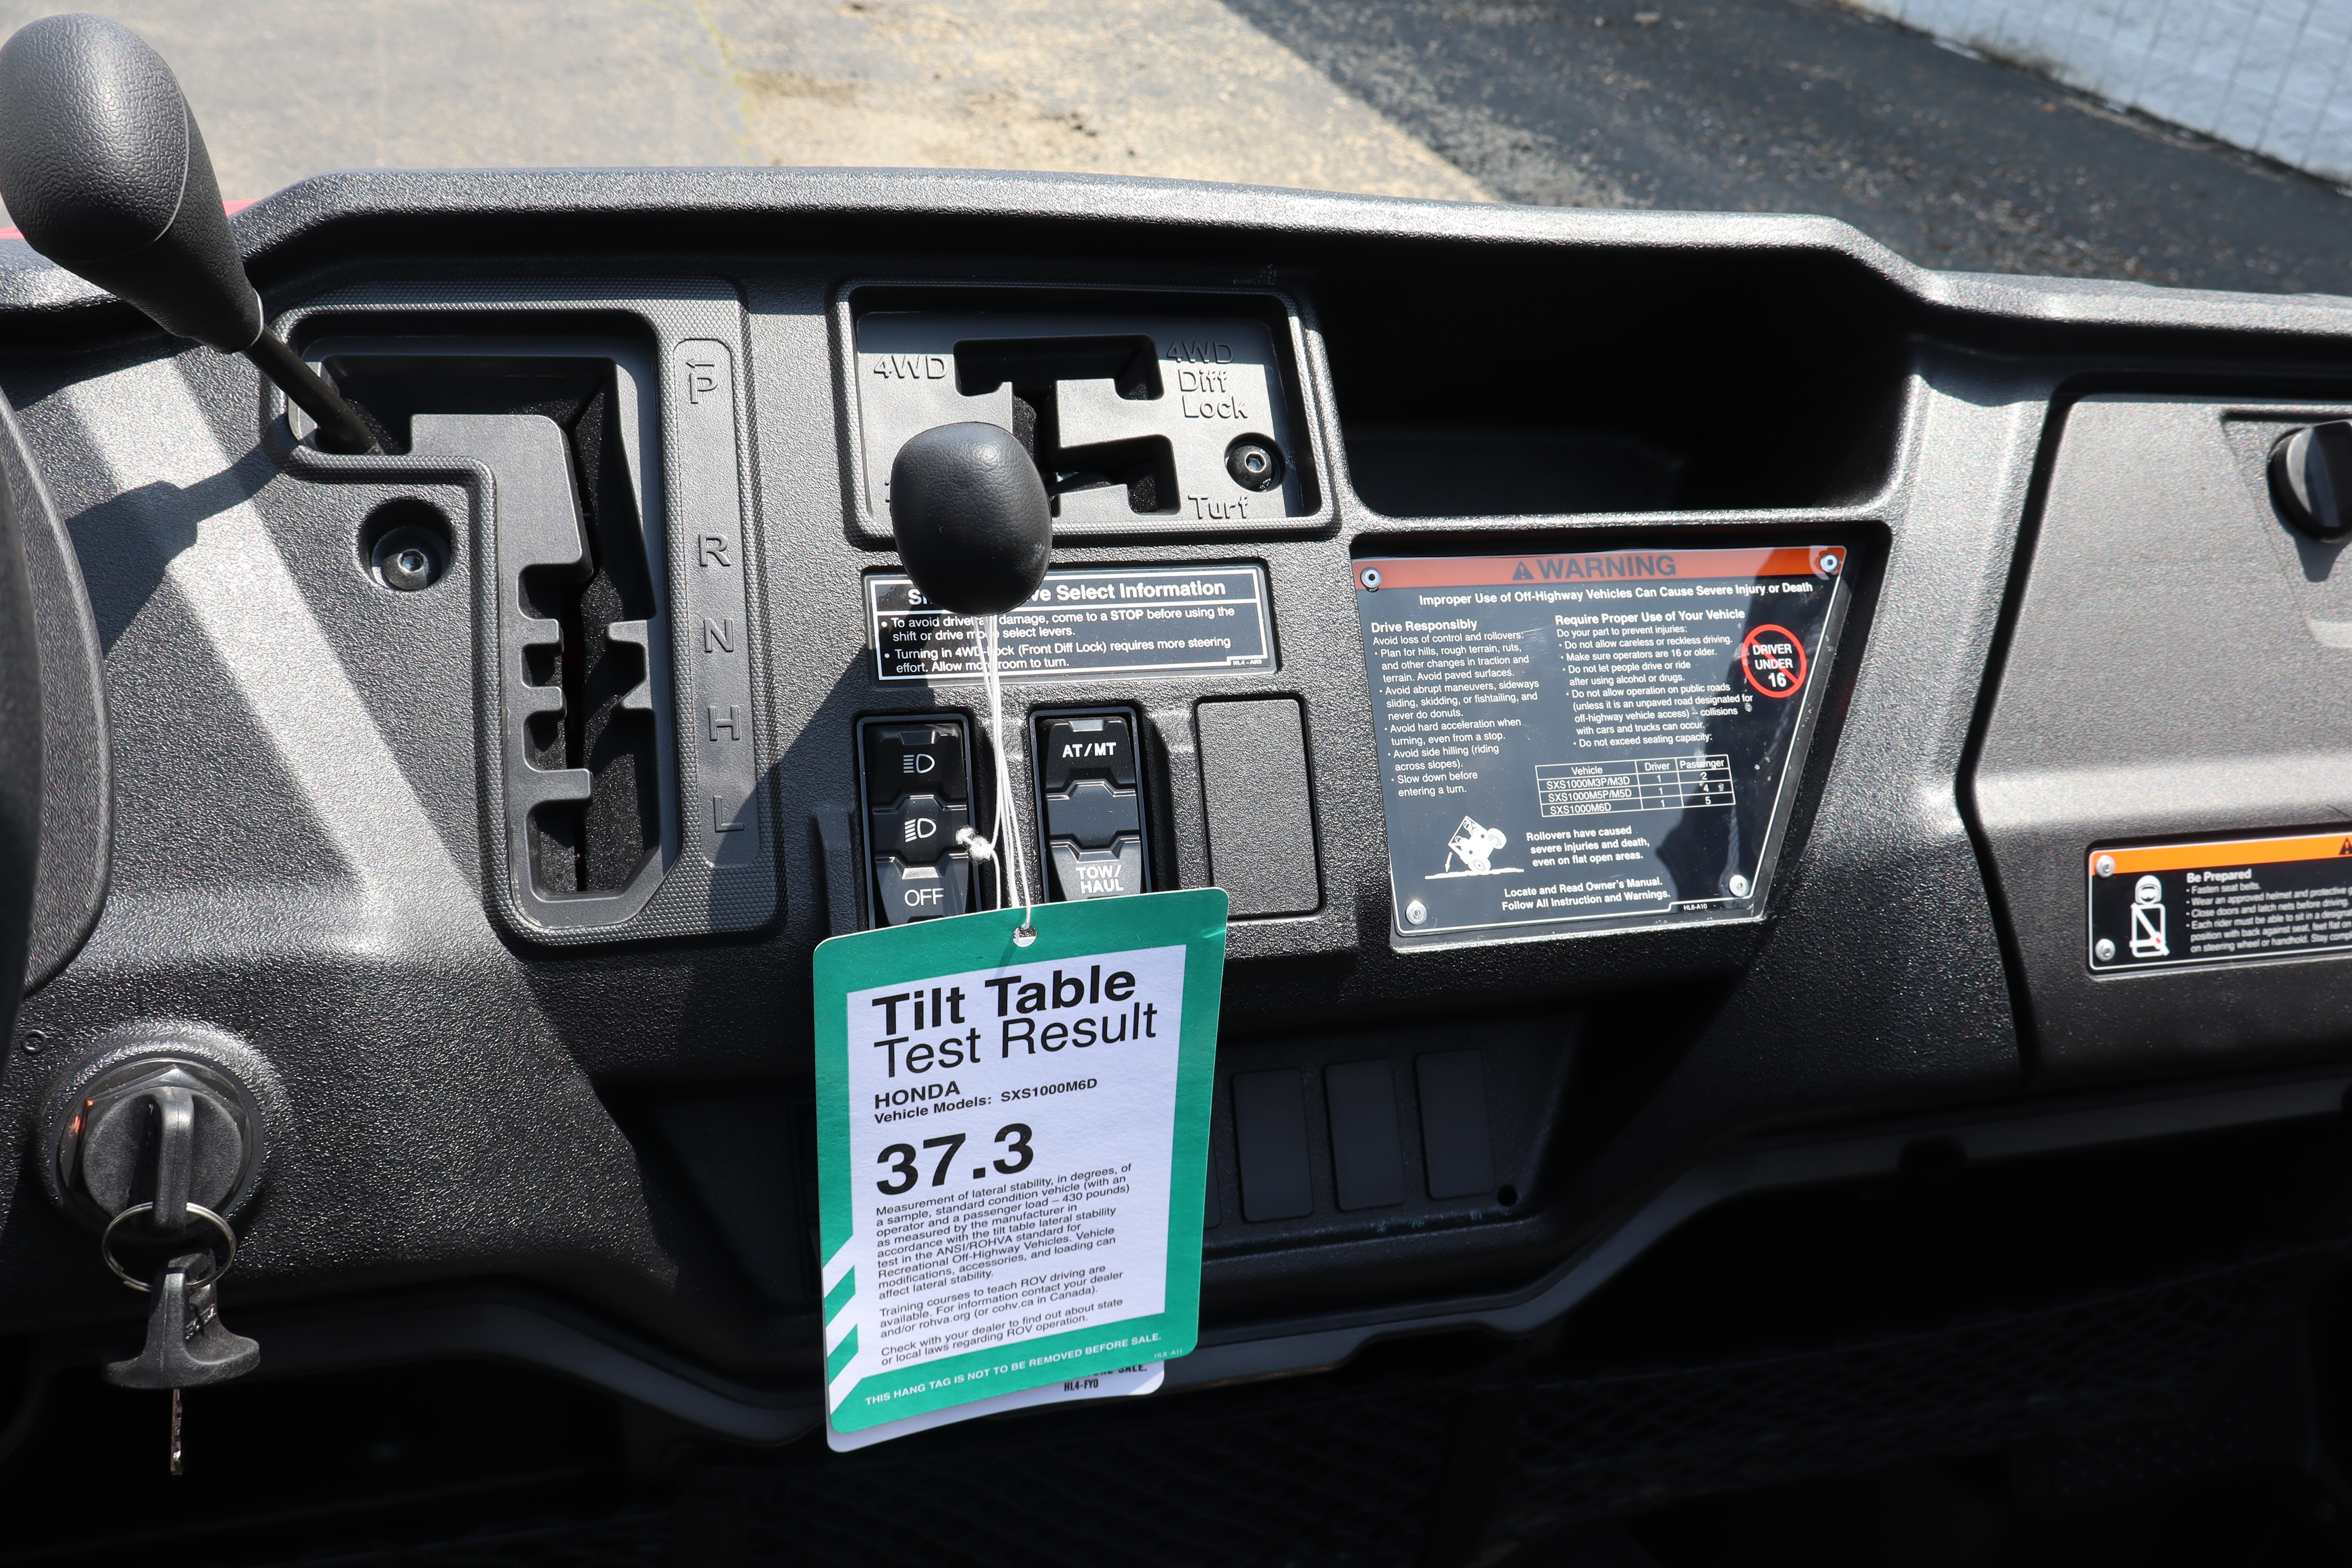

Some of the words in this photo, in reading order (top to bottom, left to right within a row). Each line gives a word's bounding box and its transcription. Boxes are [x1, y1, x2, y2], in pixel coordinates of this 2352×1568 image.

[1167, 340, 1234, 364] 4WD
[874, 353, 948, 379] 4WD
[688, 372, 718, 403] P
[1178, 369, 1227, 392] Diff
[1182, 395, 1248, 419] Lock
[1188, 494, 1248, 519] Turf
[699, 533, 731, 567] R
[1537, 555, 1677, 579] WARNING
[1056, 584, 1115, 600] Select
[1120, 581, 1225, 598] Information
[1419, 595, 1472, 607] Improper
[1475, 593, 1497, 603] Use
[1500, 592, 1511, 602] of
[1515, 591, 1583, 603] Off-Highway
[1586, 588, 1632, 599] Vehicles
[1635, 588, 1657, 597] Can
[1660, 587, 1693, 597] Cause
[1696, 586, 1733, 595] Severe
[1735, 584, 1765, 596] Injury
[1782, 582, 1813, 592] Death
[891, 617, 905, 627] To
[909, 617, 940, 627] avoid
[999, 615, 1048, 626] damage,
[1052, 614, 1083, 622] come
[1086, 612, 1097, 621] to
[1110, 610, 1143, 621] STOP
[1147, 609, 1182, 620] before
[1185, 608, 1214, 619] using
[1217, 606, 1234, 616] the
[1371, 622, 1402, 632] Drive
[1405, 619, 1477, 633] Responsibly
[1555, 614, 1599, 627] Require
[1601, 613, 1638, 625] Proper
[1641, 612, 1662, 622] Use
[1665, 611, 1675, 621] of
[1678, 611, 1703, 620] Your
[1706, 609, 1745, 619] Vehicle
[704, 617, 734, 652] N
[893, 631, 917, 641] shift
[935, 630, 963, 640] drive
[1003, 628, 1036, 638] select
[1039, 626, 1075, 636] levers.
[1373, 636, 1398, 645] Avoid
[1421, 634, 1429, 643] of
[1432, 633, 1462, 642] control
[1465, 632, 1481, 641] and
[1484, 631, 1526, 640] rollovers:
[1571, 630, 1590, 639] your
[1593, 628, 1610, 637] part
[1622, 626, 1653, 637] prevent
[1655, 625, 1687, 635] injuries:
[895, 648, 938, 661] Turning
[942, 648, 952, 657] in
[1018, 644, 1052, 657] (Front
[1054, 642, 1073, 653] Diff
[1076, 641, 1106, 653] Lock)
[1111, 639, 1154, 653] requires
[1157, 640, 1185, 649] more
[1188, 637, 1230, 648] steering
[1753, 644, 1792, 655] DRIVER
[897, 663, 928, 672] effort.
[932, 661, 962, 671] Allow
[998, 659, 1027, 669] room
[1030, 659, 1041, 668] to
[1044, 658, 1069, 667] turn.
[1755, 659, 1793, 670] UNDER
[1768, 672, 1786, 687] 16
[709, 706, 740, 740] H
[1062, 742, 1117, 758] AT/MT
[1395, 763, 1425, 771] across
[1428, 759, 1463, 770] slopes).
[1571, 766, 1602, 775] Vehicle
[1645, 762, 1670, 771] Driver
[1679, 759, 1724, 769] Passenger
[1547, 777, 1630, 789] SXS1000M3P/M3D
[1548, 789, 1632, 802] SXS1000M5P/M5D
[713, 796, 745, 832] L
[1550, 804, 1612, 815] SXS1000M6D
[1526, 831, 1571, 841] Rollovers
[1573, 829, 1596, 838] have
[1599, 826, 1632, 836] caused
[1531, 845, 1562, 854] severe
[1564, 841, 1599, 853] injuries
[1601, 839, 1619, 849] and
[1621, 837, 1650, 847] death,
[1572, 855, 1587, 864] flat
[1590, 855, 1613, 864] open
[1615, 852, 1643, 860] areas.
[1076, 865, 1121, 880] TOW/
[2187, 873, 2201, 883] Be
[2204, 869, 2251, 882] Prepared
[1080, 879, 1124, 894] HAUL
[1504, 887, 1537, 897] Locate
[1539, 885, 1557, 895] and
[1559, 883, 1583, 893] Read
[1626, 877, 1662, 887] Manual.
[905, 888, 944, 906] OFF
[1502, 901, 1533, 911] Follow
[1536, 898, 1549, 907] All
[1551, 895, 1602, 906] Instruction
[1604, 893, 1622, 902] and
[1624, 890, 1670, 900] Warnings.
[872, 987, 965, 1036] Tilt
[985, 964, 1136, 1018] Table
[874, 1027, 981, 1078] Test
[1002, 1002, 1158, 1059] Result
[875, 1081, 960, 1109] HONDA
[875, 1107, 928, 1123] Vehicle
[934, 1097, 991, 1113] Models:
[1001, 1079, 1097, 1102] SXS1000M6D
[876, 1123, 1034, 1196] 37.3
[880, 1286, 909, 1299] affect
[913, 1278, 946, 1292] lateral
[951, 1271, 993, 1284] stability.
[866, 1393, 890, 1405] THIS
[894, 1384, 925, 1398] HANG
[929, 1378, 951, 1389] TAG
[955, 1375, 964, 1383] IS
[968, 1369, 990, 1380] NOT
[993, 1365, 1008, 1374] TO
[1012, 1361, 1025, 1370] BE
[1029, 1349, 1082, 1367] REMOVED
[1085, 1339, 1128, 1354] BEFORE
[1132, 1333, 1161, 1345] SALE.
